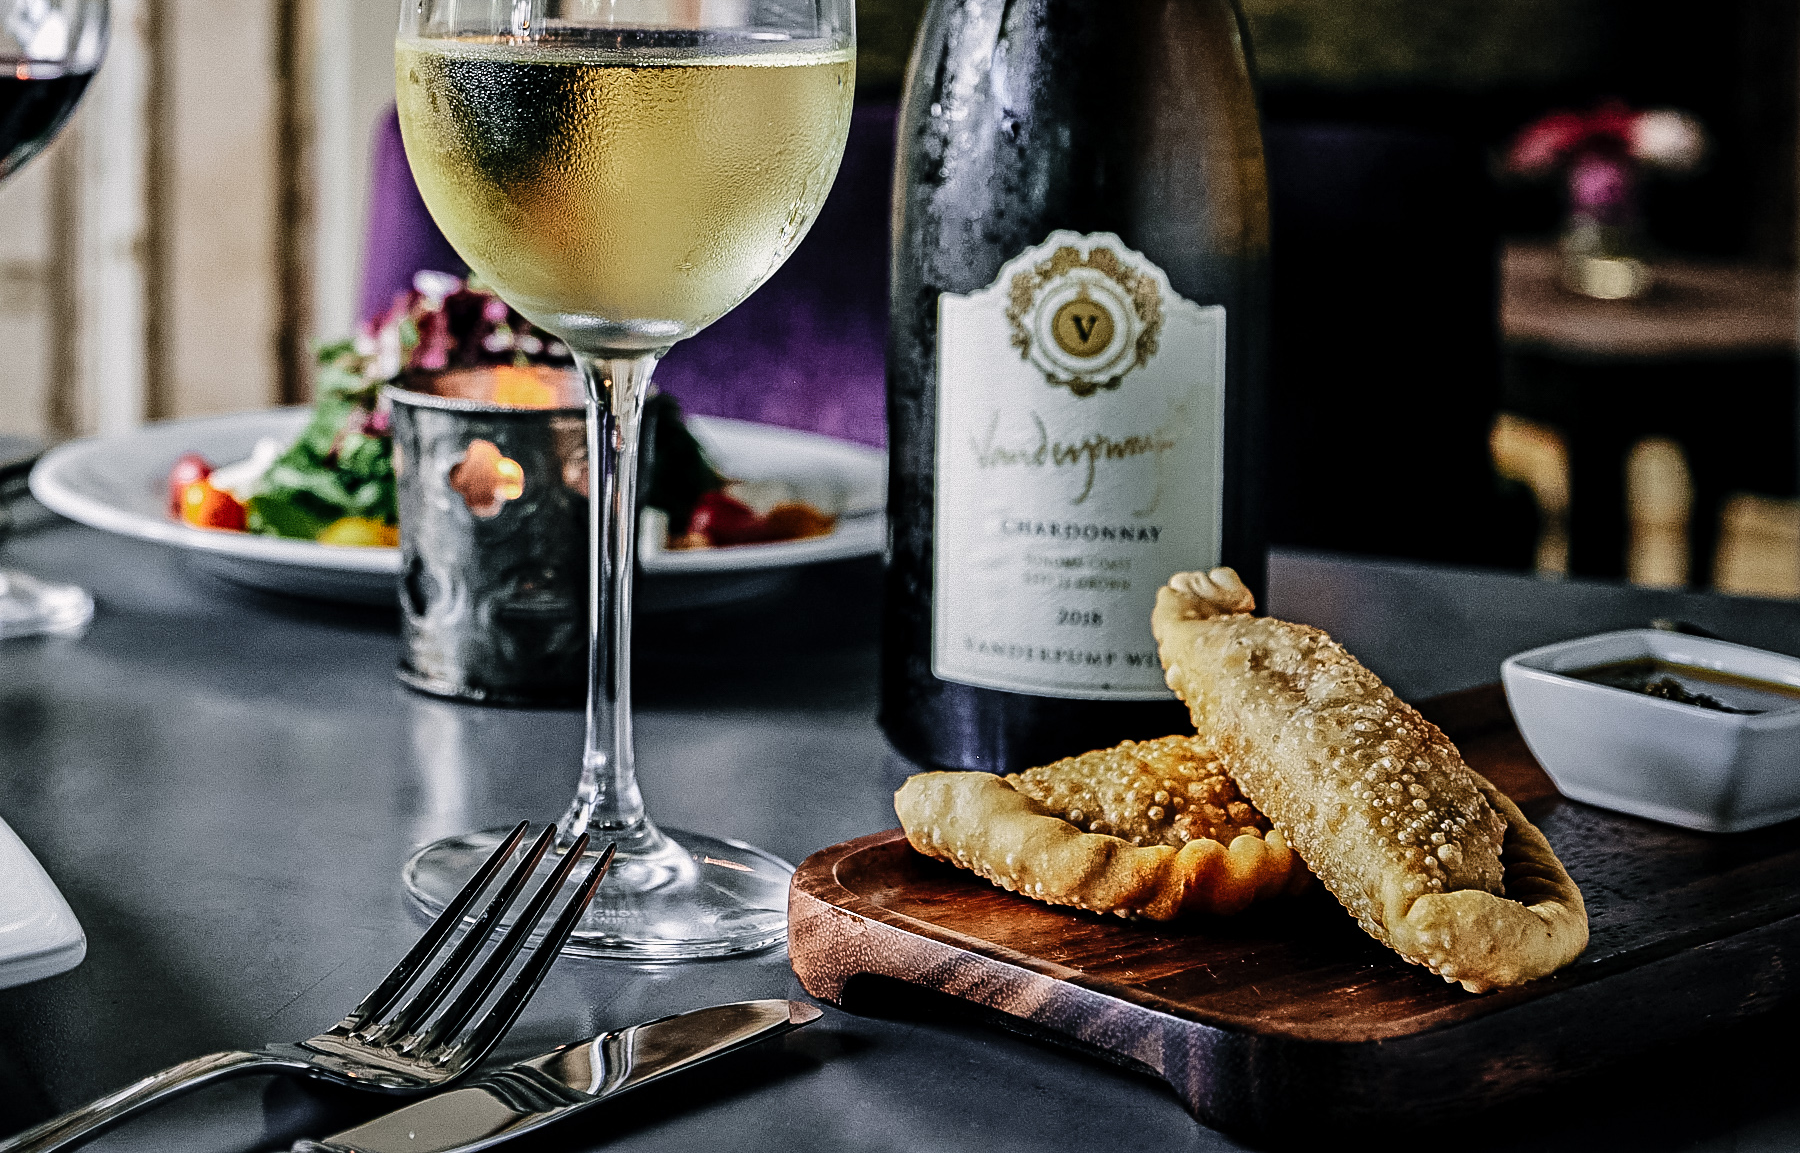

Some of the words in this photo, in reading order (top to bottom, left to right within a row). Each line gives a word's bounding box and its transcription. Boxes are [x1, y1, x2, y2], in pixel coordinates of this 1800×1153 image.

[1072, 314, 1098, 343] V
[1002, 520, 1163, 543] CHARDONNAY
[1056, 607, 1104, 627] 2018
[963, 635, 1117, 667] VANDERPUMP
